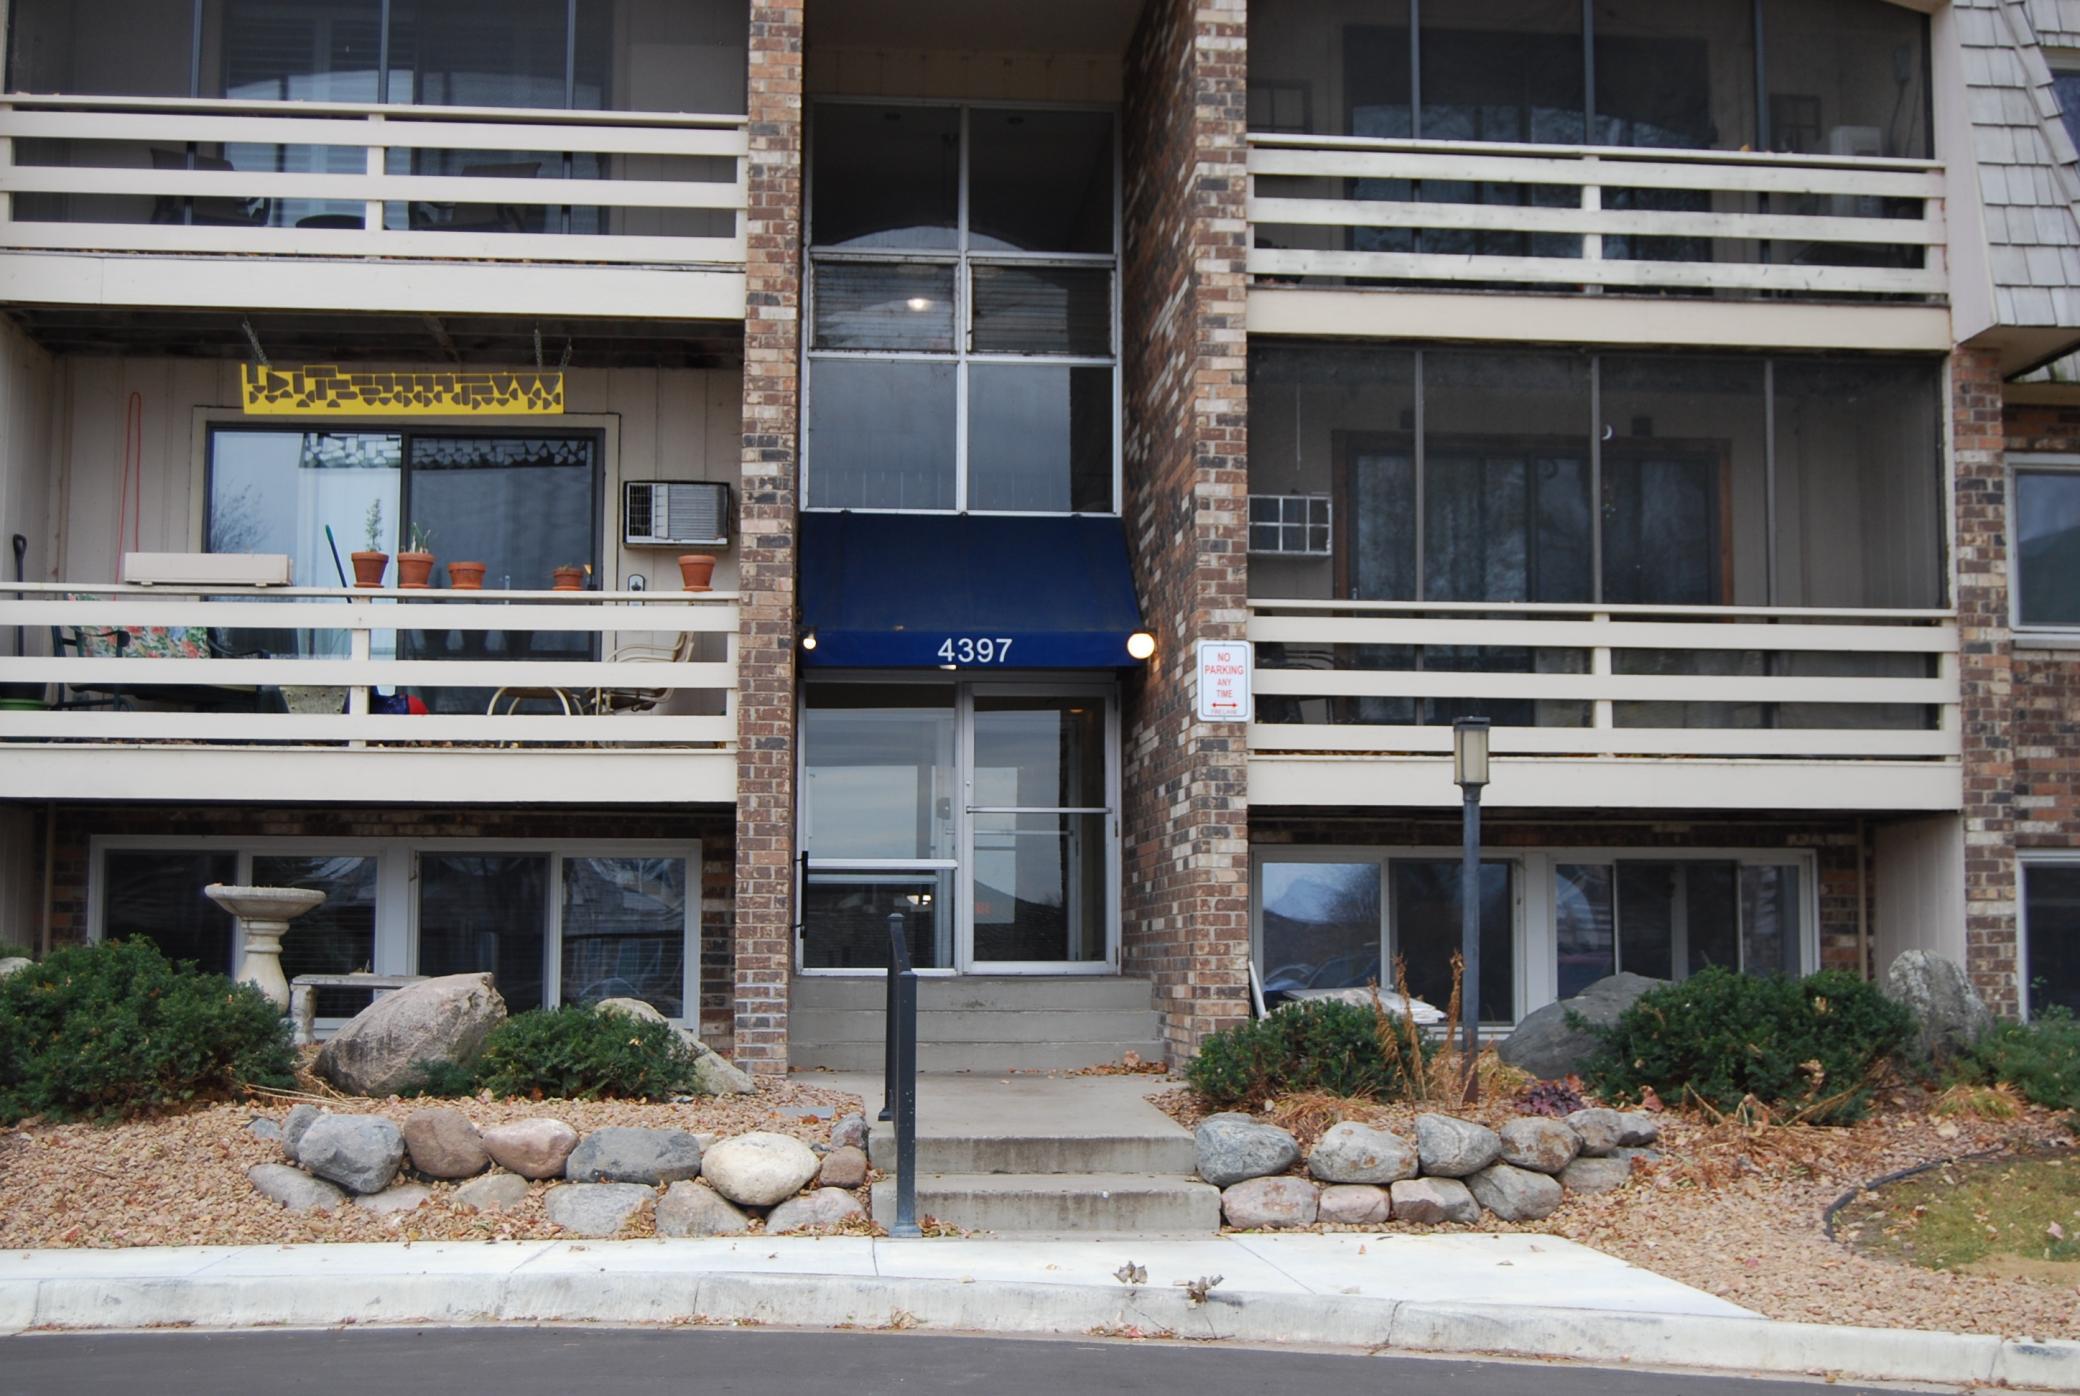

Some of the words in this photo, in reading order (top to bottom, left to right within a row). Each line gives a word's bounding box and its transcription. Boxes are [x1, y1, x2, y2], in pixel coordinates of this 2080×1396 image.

[938, 638, 1013, 662] 4397
[1217, 652, 1231, 662] NO
[1204, 664, 1244, 675] PARKING
[1217, 678, 1232, 686] ANY
[1216, 689, 1233, 698] TIME
